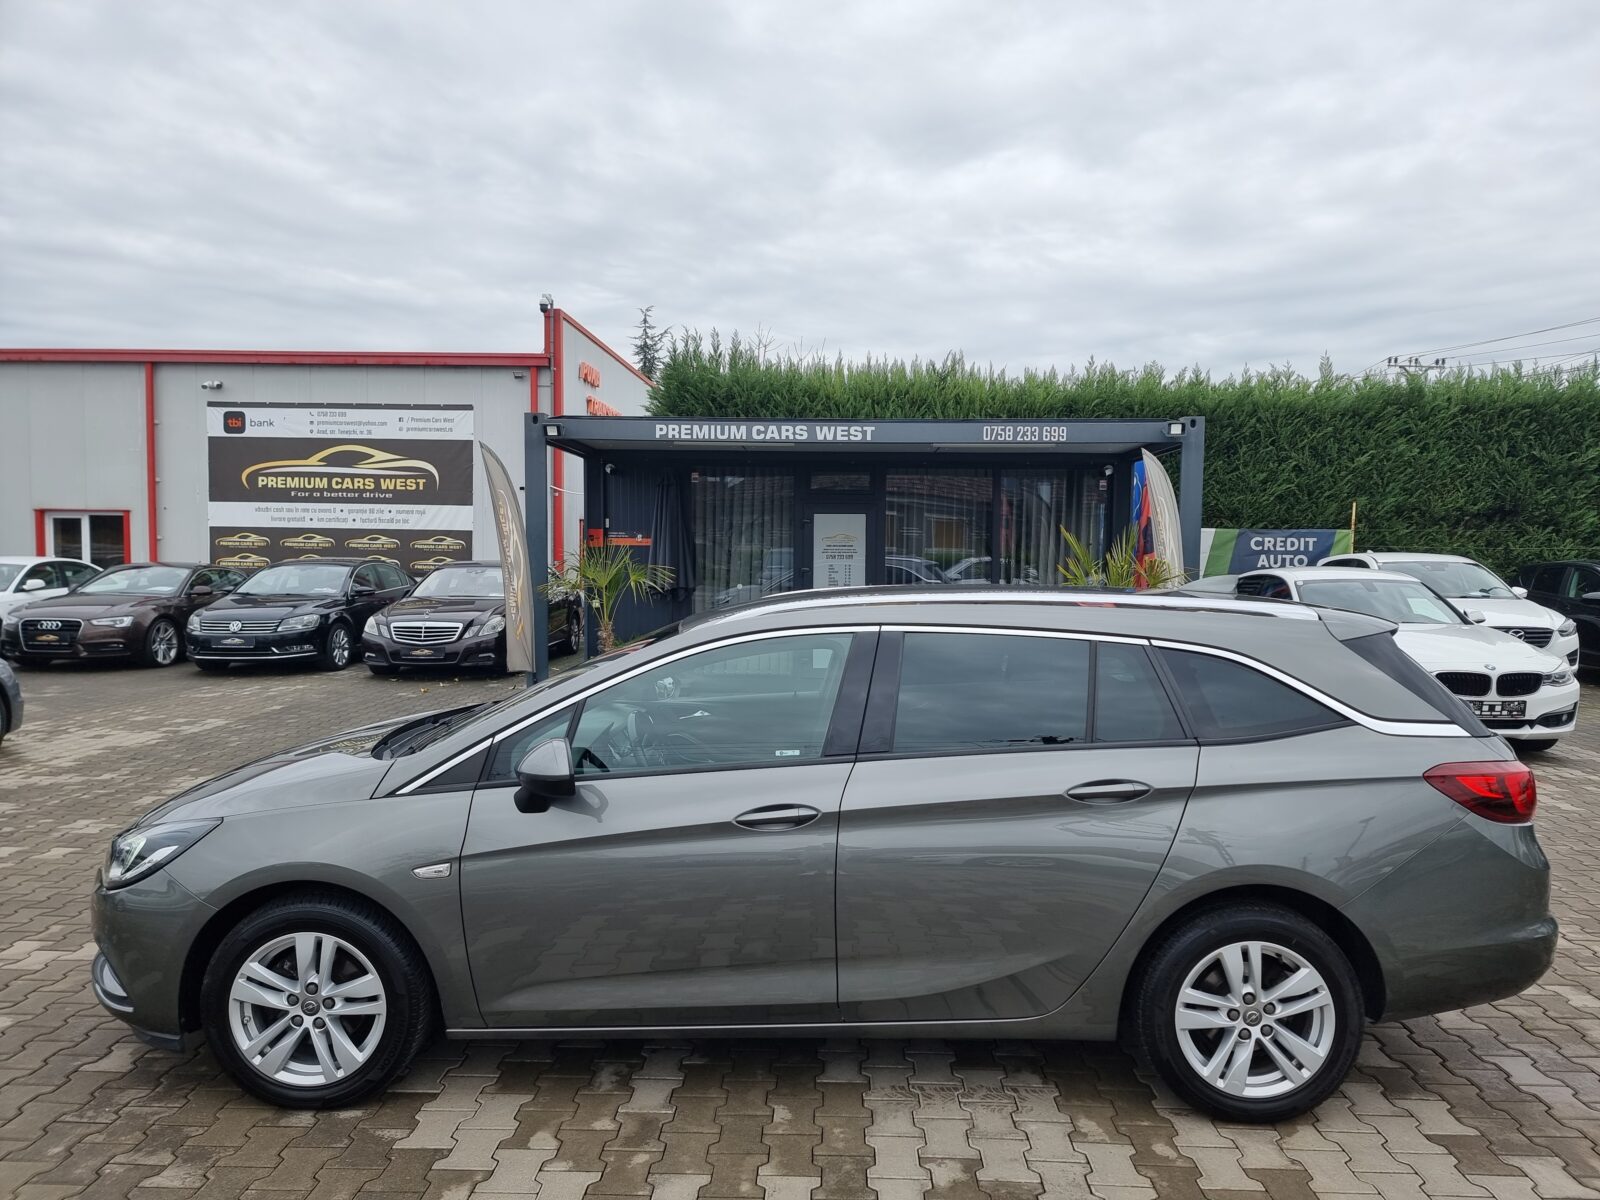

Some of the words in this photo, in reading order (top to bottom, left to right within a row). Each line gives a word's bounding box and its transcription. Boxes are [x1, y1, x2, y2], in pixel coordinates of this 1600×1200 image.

[227, 417, 242, 428] tbi
[250, 418, 275, 428] bank
[656, 424, 746, 440] PREMIUM
[752, 425, 808, 440] CARS
[816, 426, 876, 441] WEST
[983, 426, 1013, 441] 0758
[1016, 426, 1039, 441] 233
[1042, 426, 1067, 442] 699
[258, 476, 328, 489] PREMIUM
[332, 477, 375, 490] CARS
[380, 478, 426, 490] WEST
[1250, 537, 1318, 551] CREDIT
[1256, 554, 1308, 568] AUTO
